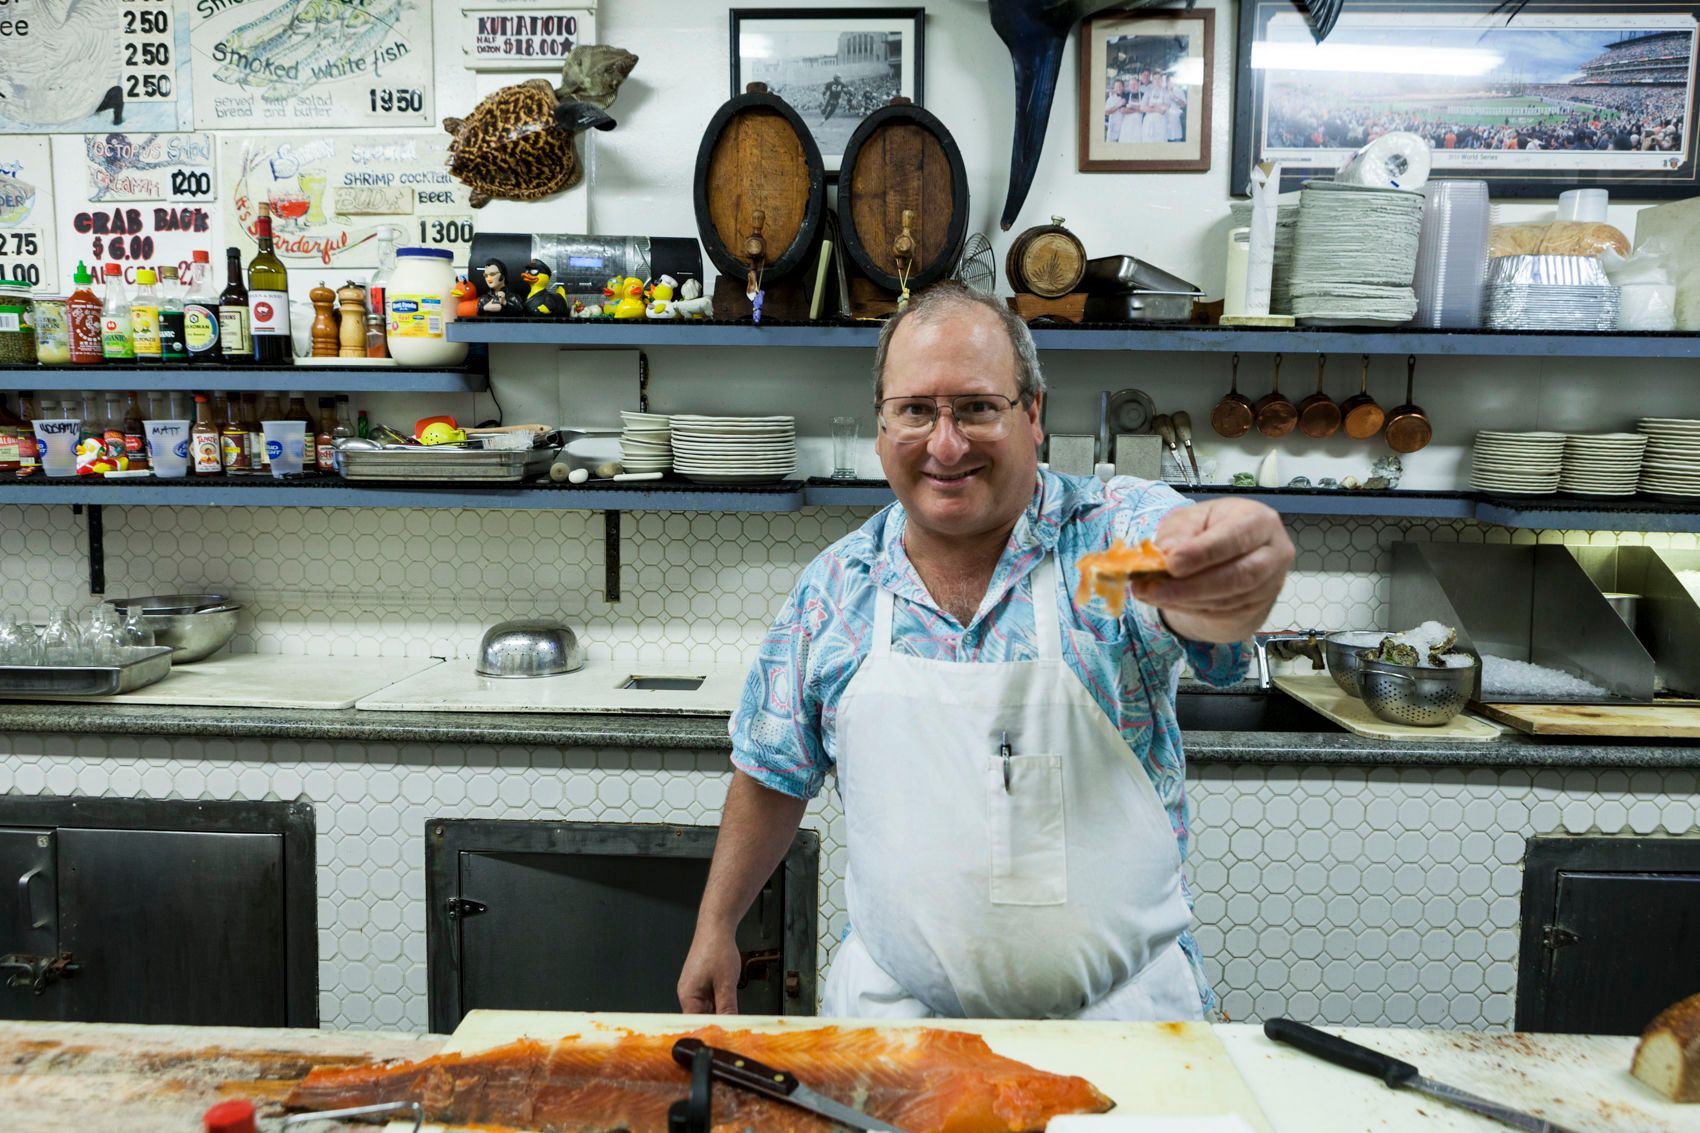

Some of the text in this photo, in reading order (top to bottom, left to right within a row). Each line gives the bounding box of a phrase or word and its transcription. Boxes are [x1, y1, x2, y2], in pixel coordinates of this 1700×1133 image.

[123, 10, 168, 34] 250
[478, 16, 577, 36] KUMAMOTO
[477, 36, 497, 44] HALF
[503, 38, 559, 56] $18.00
[124, 43, 169, 66] 250
[212, 41, 409, 81] Smoked white fish
[126, 75, 171, 97] 250
[369, 88, 422, 112] 1950
[215, 106, 253, 118] bread
[171, 169, 211, 197] 1200
[419, 220, 474, 243] 1300
[152, 426, 181, 436] MATT
